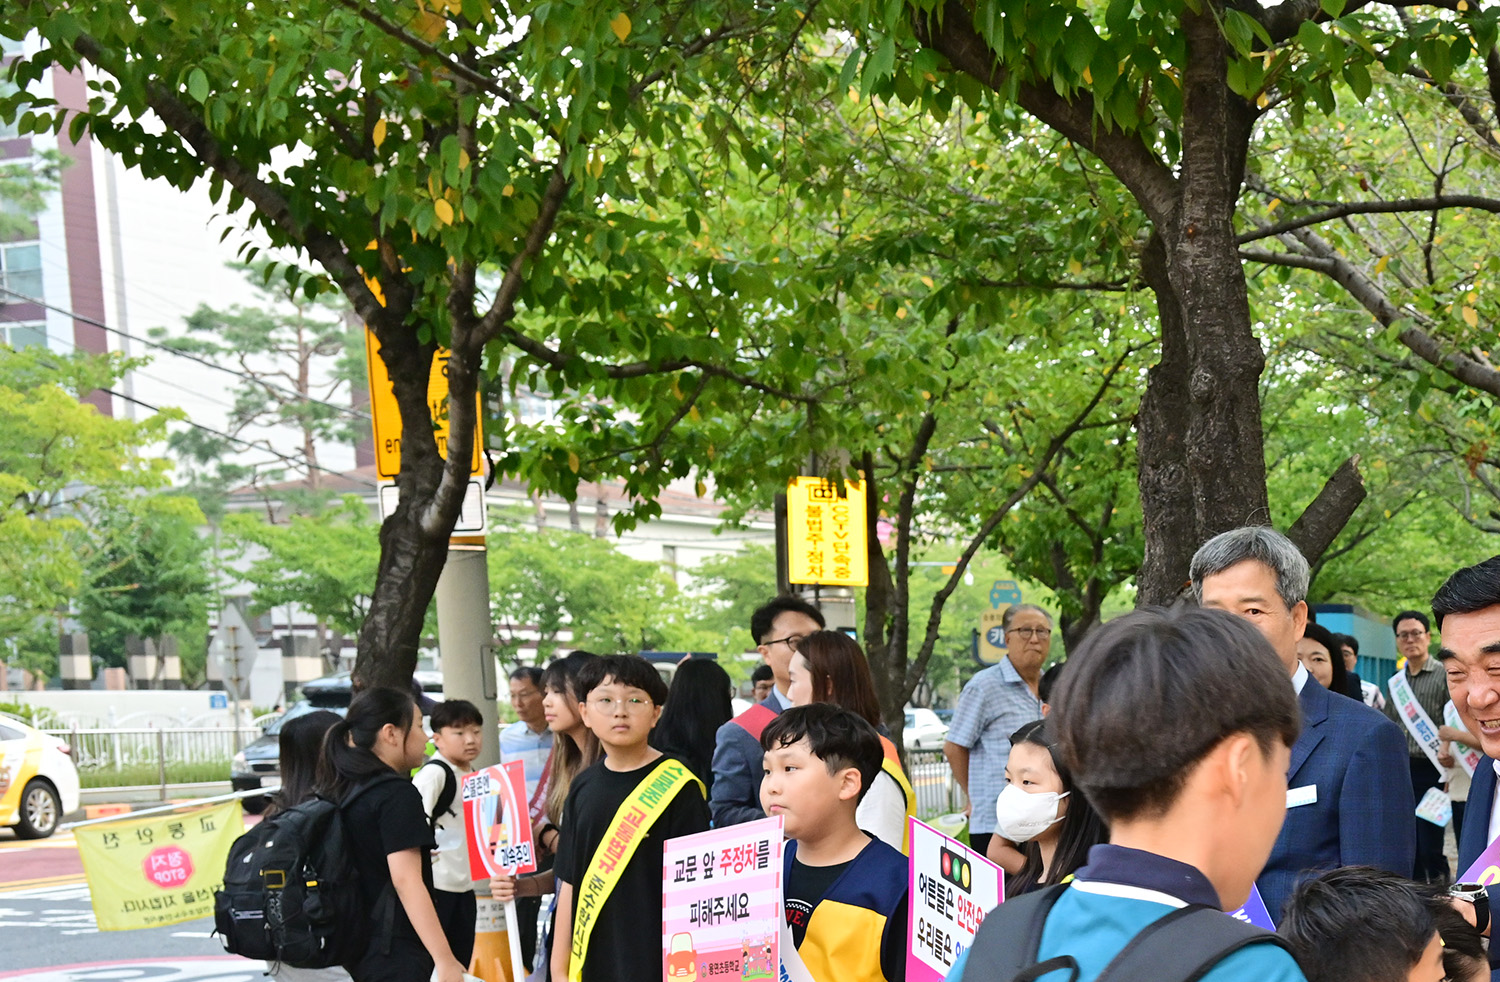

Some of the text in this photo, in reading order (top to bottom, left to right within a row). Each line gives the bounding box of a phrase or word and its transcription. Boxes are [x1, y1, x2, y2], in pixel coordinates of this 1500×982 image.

[572, 766, 683, 960] 스쿨존 교통법규 준수합시다
[674, 840, 770, 882] 교문 앞 주정차를
[690, 892, 750, 928] 피해주세요
[919, 873, 954, 921] 어른들은
[918, 917, 952, 967] 우리들은
